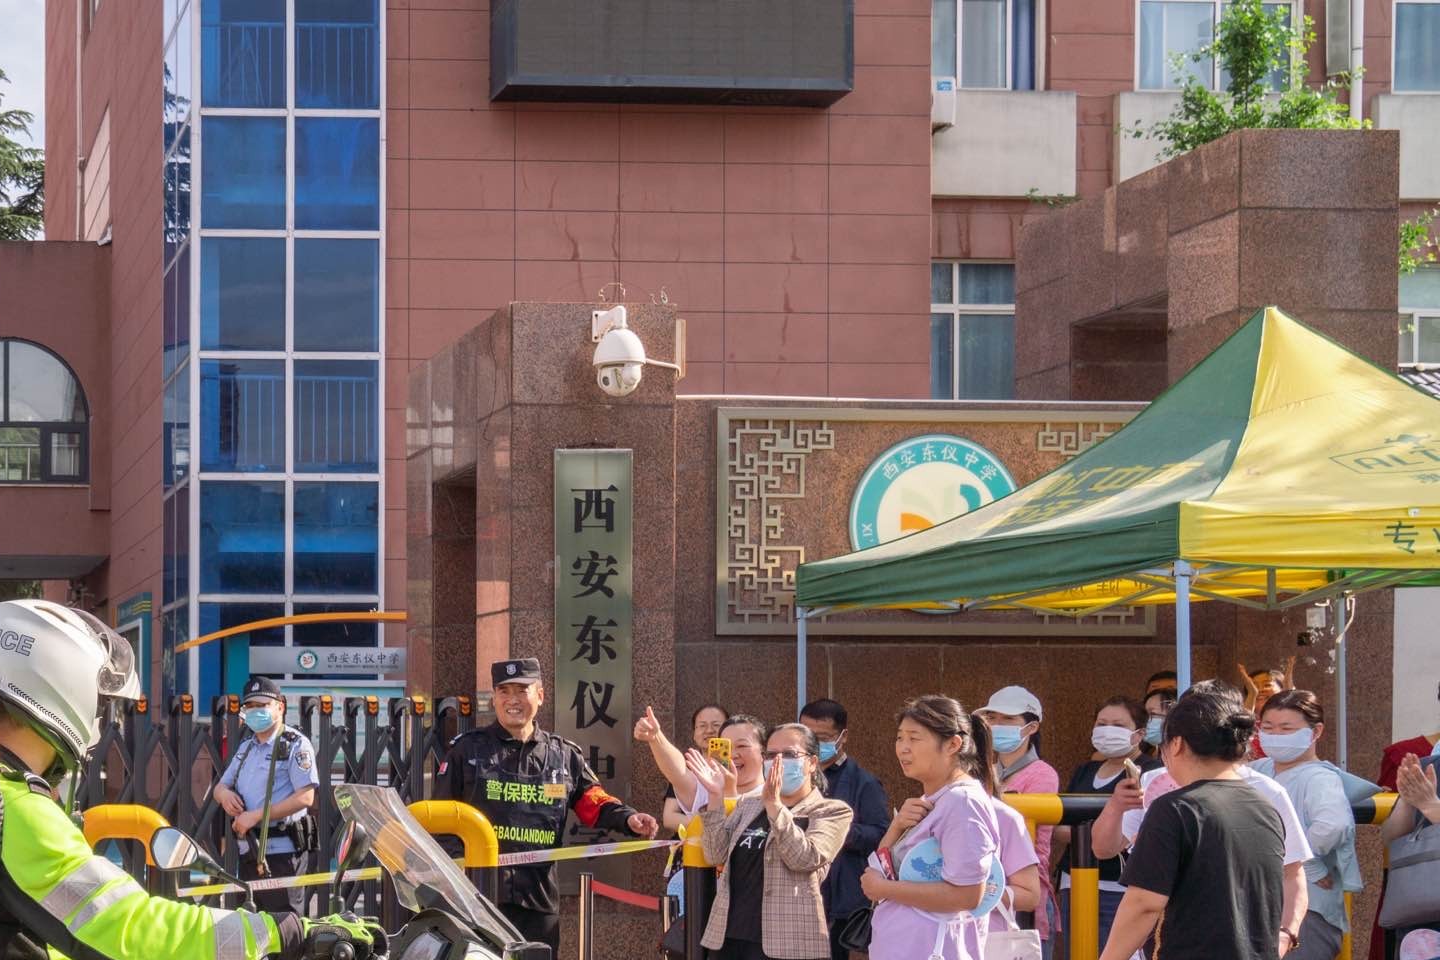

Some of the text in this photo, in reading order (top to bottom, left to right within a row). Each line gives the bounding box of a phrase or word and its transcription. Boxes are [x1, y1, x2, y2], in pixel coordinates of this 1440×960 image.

[880, 443, 998, 482] 西安东仪中学
[327, 652, 400, 664] 西安东仪中学
[486, 779, 555, 806] 警保联动
